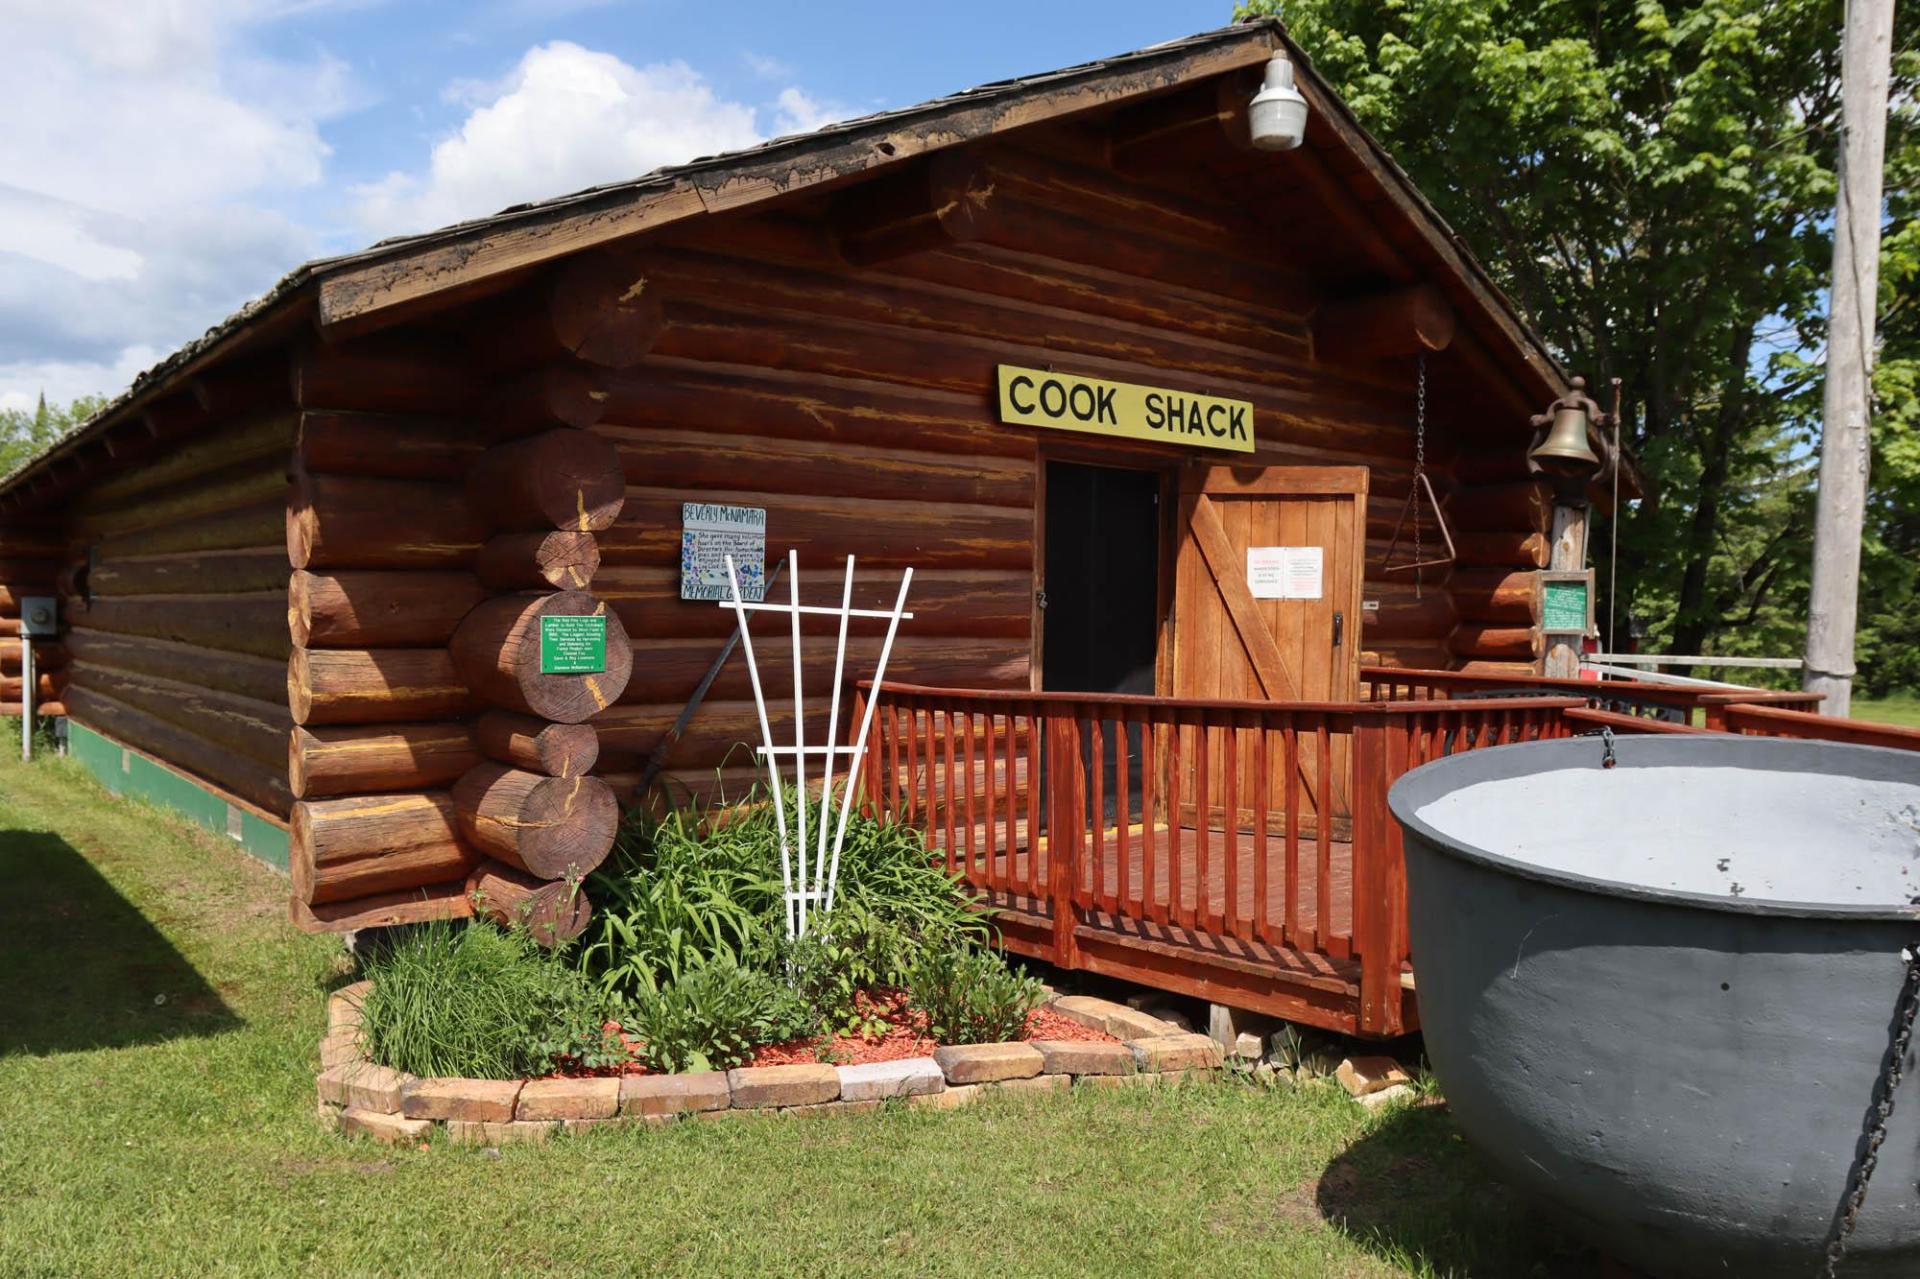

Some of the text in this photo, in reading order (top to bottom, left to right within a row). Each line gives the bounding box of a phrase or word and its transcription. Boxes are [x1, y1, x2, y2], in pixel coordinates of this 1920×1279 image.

[1009, 375, 1247, 441] COOK SHACK
[684, 504, 718, 522] BEVERLY
[683, 584, 763, 600] MEMORIAL GRDEN
